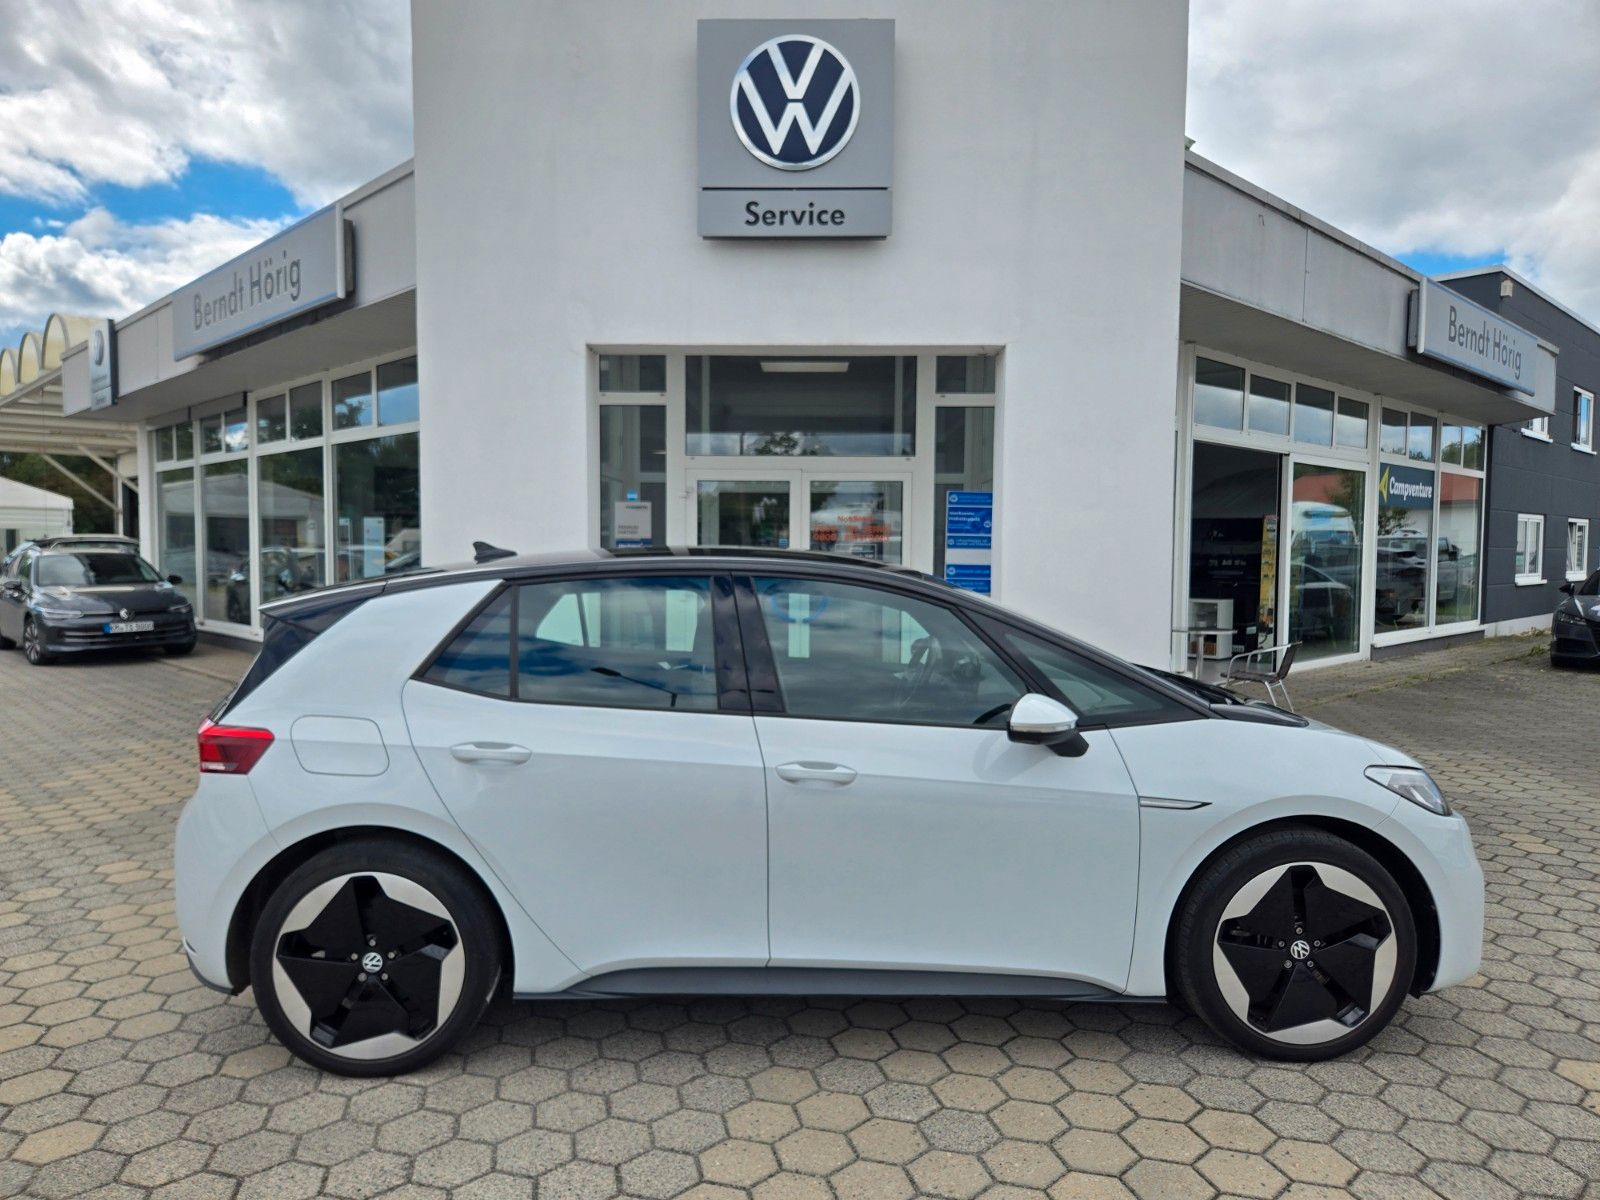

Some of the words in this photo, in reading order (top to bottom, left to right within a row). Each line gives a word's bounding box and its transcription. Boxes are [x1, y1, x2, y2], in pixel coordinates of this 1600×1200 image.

[732, 36, 859, 170] VW
[744, 201, 846, 227] Service
[194, 271, 243, 331] Berndt
[250, 249, 301, 306] Hörig
[1448, 305, 1490, 358] Berndt
[1493, 327, 1521, 380] Hörig
[1389, 476, 1433, 501] Campventure
